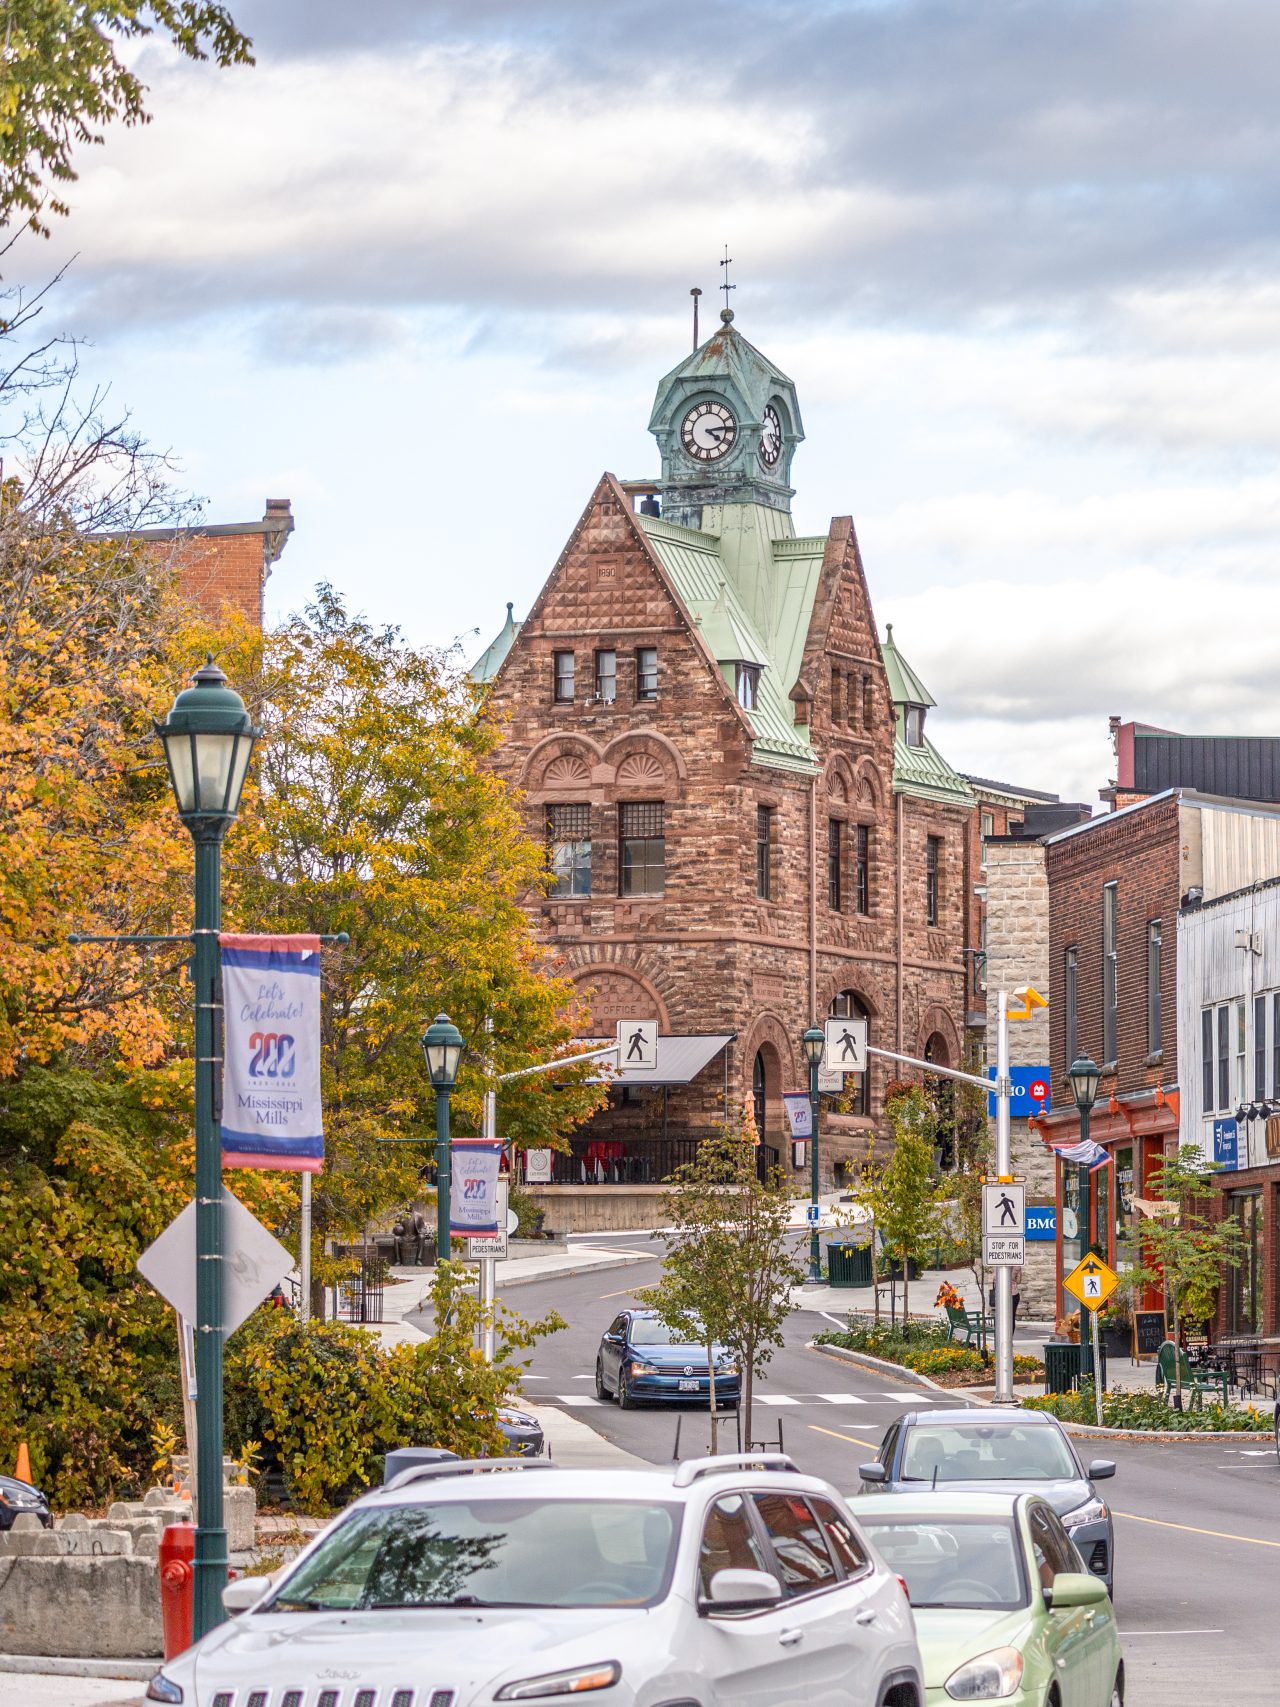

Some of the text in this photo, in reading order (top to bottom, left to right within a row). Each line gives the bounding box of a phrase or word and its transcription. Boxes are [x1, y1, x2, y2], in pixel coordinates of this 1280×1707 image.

[598, 568, 616, 577] 1890
[258, 982, 285, 1000] Let's
[240, 1001, 304, 1022] Celebrate!
[604, 1005, 637, 1015] OFFICE
[248, 1031, 296, 1079] 200
[238, 1094, 304, 1113] Mississippi
[256, 1110, 288, 1125] Mills
[464, 1179, 486, 1200] 200
[1027, 1218, 1057, 1229] BMO
[472, 1245, 505, 1254] PEDESTRIANS
[991, 1241, 1019, 1250] STOP FOR
[988, 1251, 1022, 1260] PEDESTRIANS
